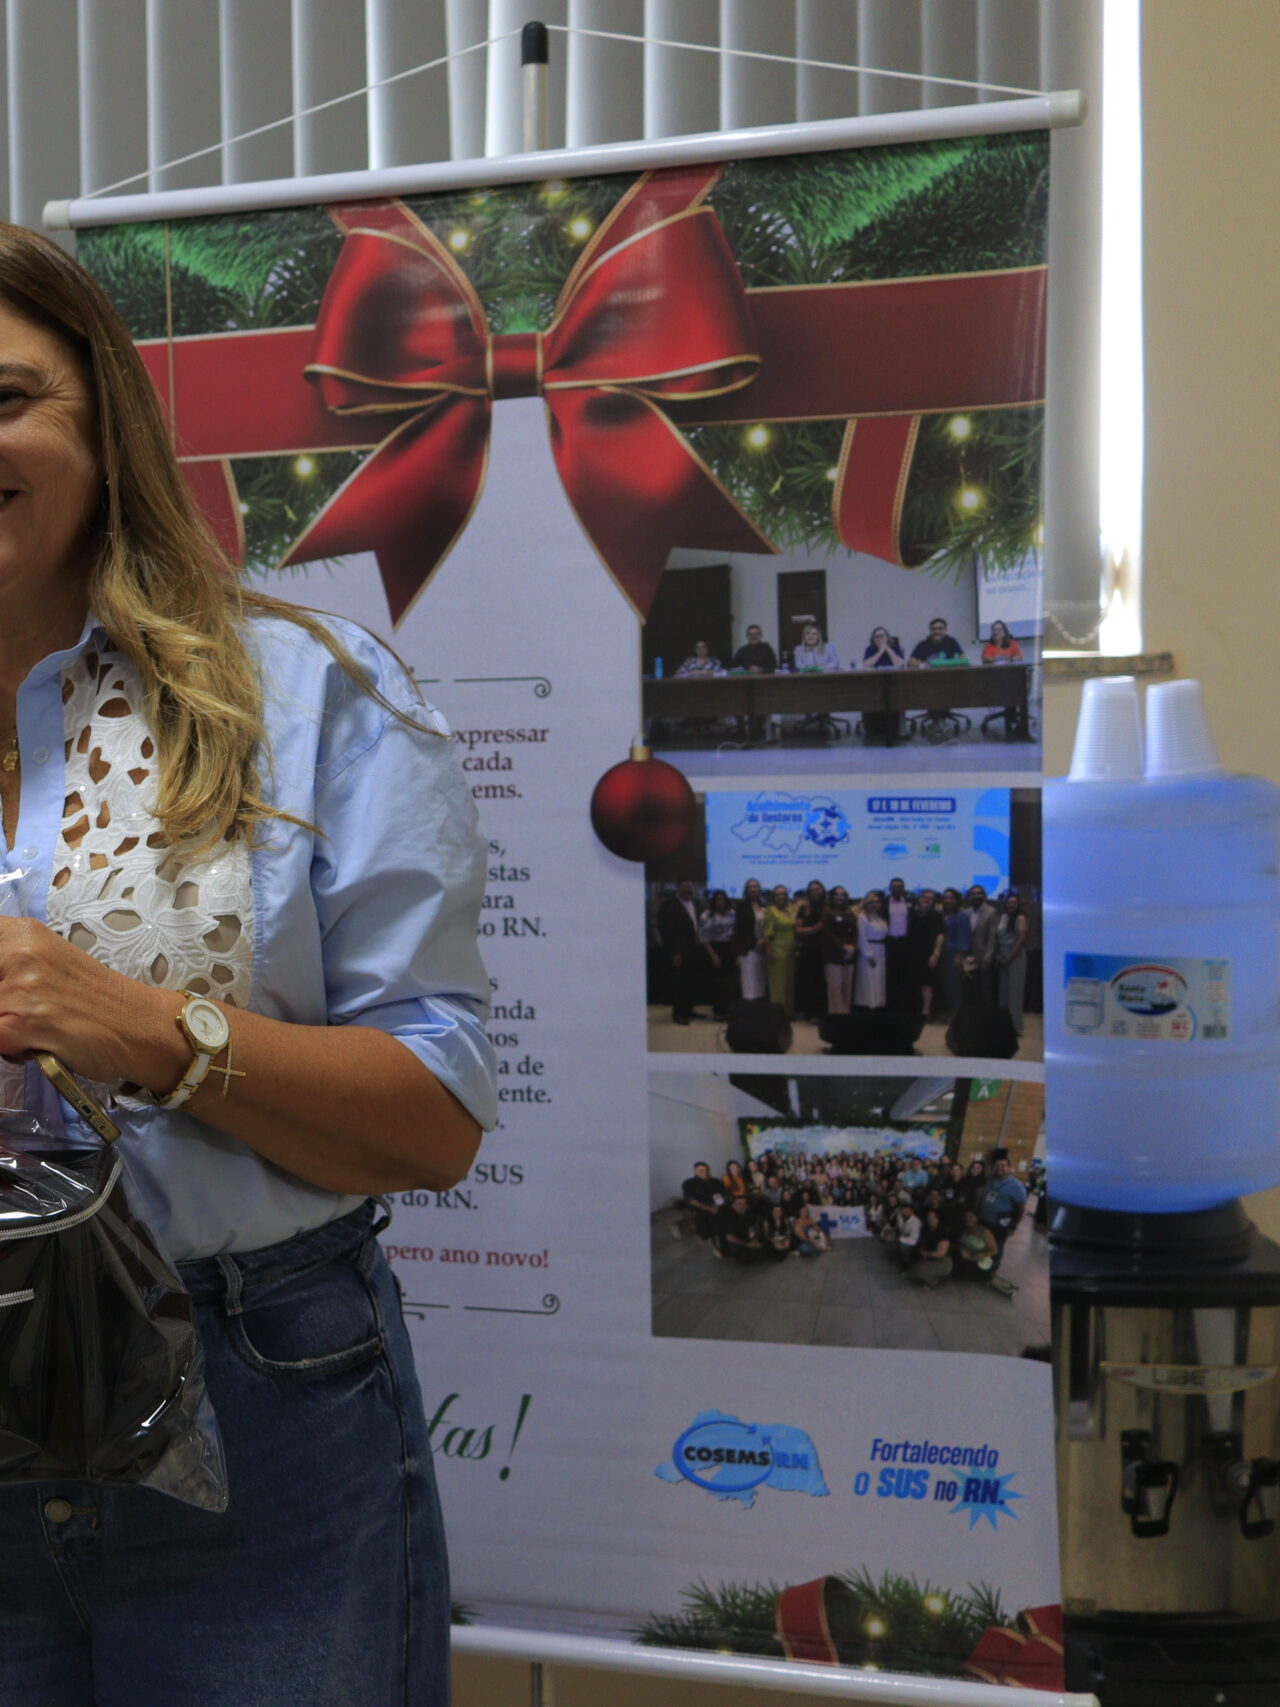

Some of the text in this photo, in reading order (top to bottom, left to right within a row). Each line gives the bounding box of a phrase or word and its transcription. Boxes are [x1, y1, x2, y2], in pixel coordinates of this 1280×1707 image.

[462, 751, 513, 772] cada
[481, 894, 515, 910] ara
[502, 916, 547, 937] RN.
[489, 999, 536, 1020] nda
[517, 1055, 545, 1076] de
[475, 1162, 524, 1185] SUS
[401, 1191, 429, 1207] do
[434, 1189, 479, 1210] RN.
[381, 1244, 549, 1269] pero ano novo!
[683, 1446, 770, 1466] COSEMS
[870, 1438, 1000, 1469] Fortalecendo
[876, 1466, 930, 1500] SUS
[934, 1480, 958, 1502] no
